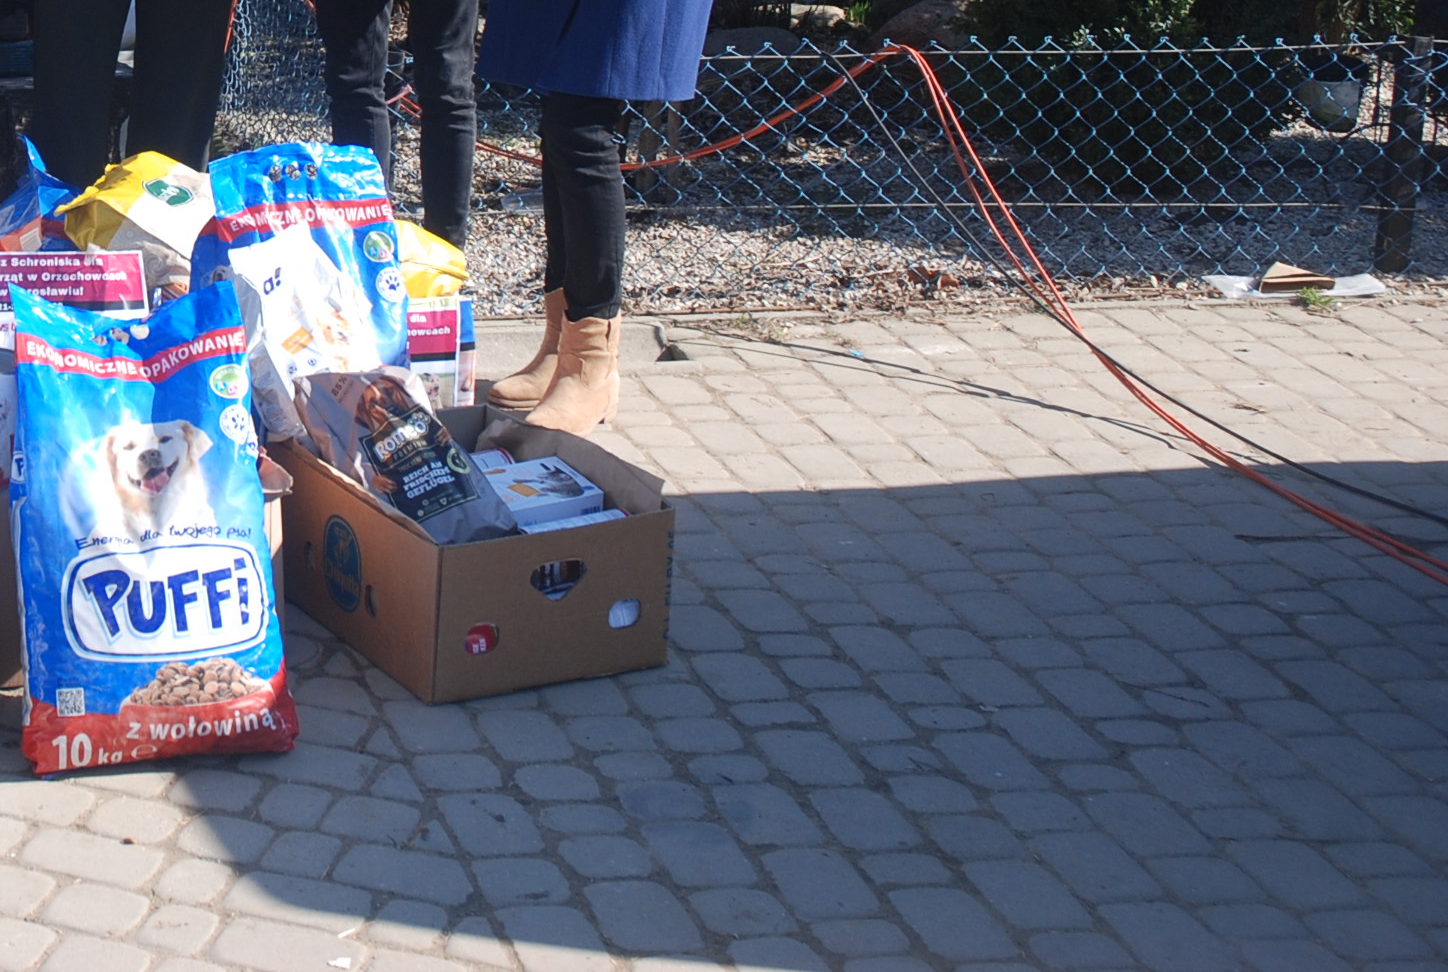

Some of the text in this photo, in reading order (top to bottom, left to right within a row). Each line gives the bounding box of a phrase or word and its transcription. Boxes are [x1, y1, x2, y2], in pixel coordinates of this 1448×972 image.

[11, 257, 80, 266] Schroniska
[25, 286, 84, 296] rosławiu!
[26, 330, 244, 378] EKONOMICZNE OPAKOWANIE
[140, 528, 163, 541] dla
[169, 525, 221, 540] twojego
[125, 710, 276, 741] z wołowiną
[51, 732, 123, 770] 10 kg
